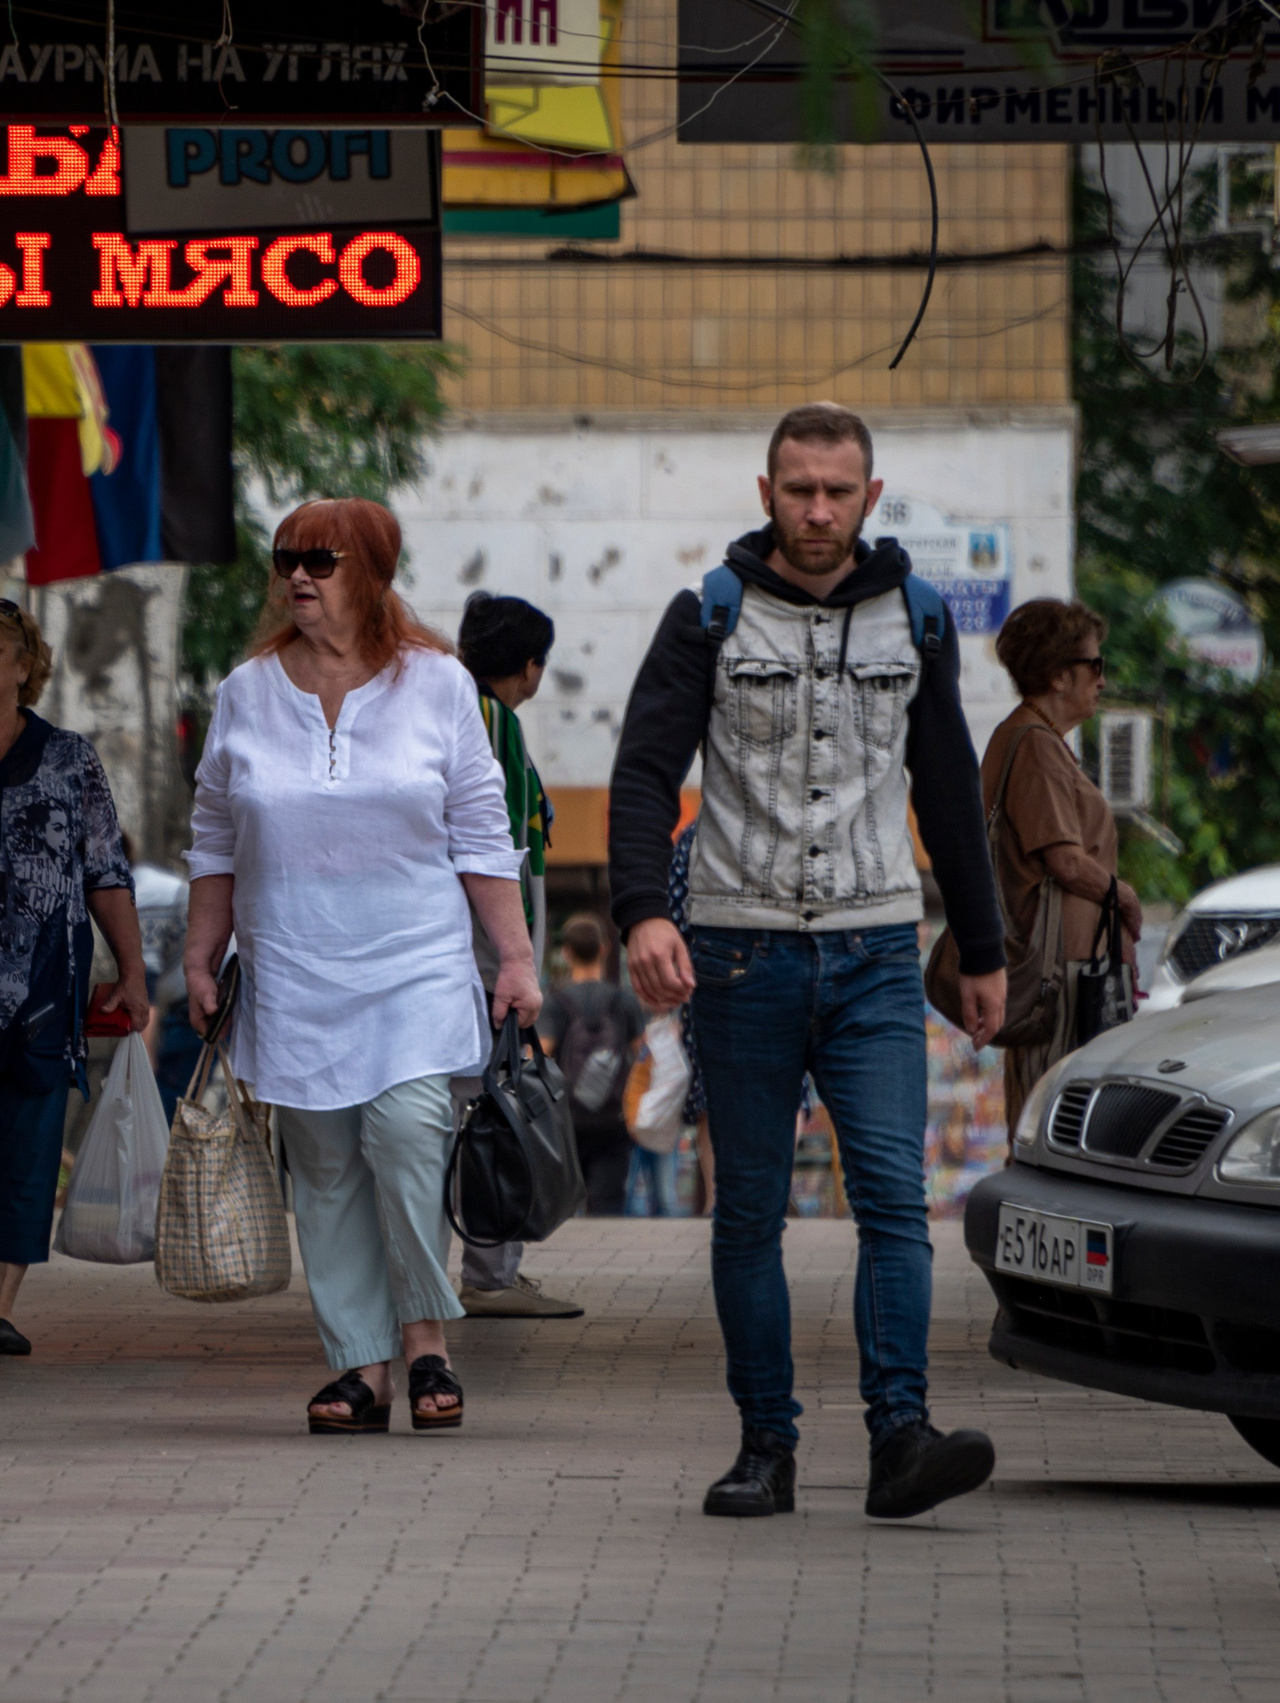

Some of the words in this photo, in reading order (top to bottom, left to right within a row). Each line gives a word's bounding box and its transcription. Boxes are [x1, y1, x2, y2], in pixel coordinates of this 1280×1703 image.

[176, 44, 247, 82] НА
[889, 80, 1224, 125] ФИРМЕННЫЙ
[165, 129, 392, 187] PROFI
[93, 232, 421, 307] МЯСО
